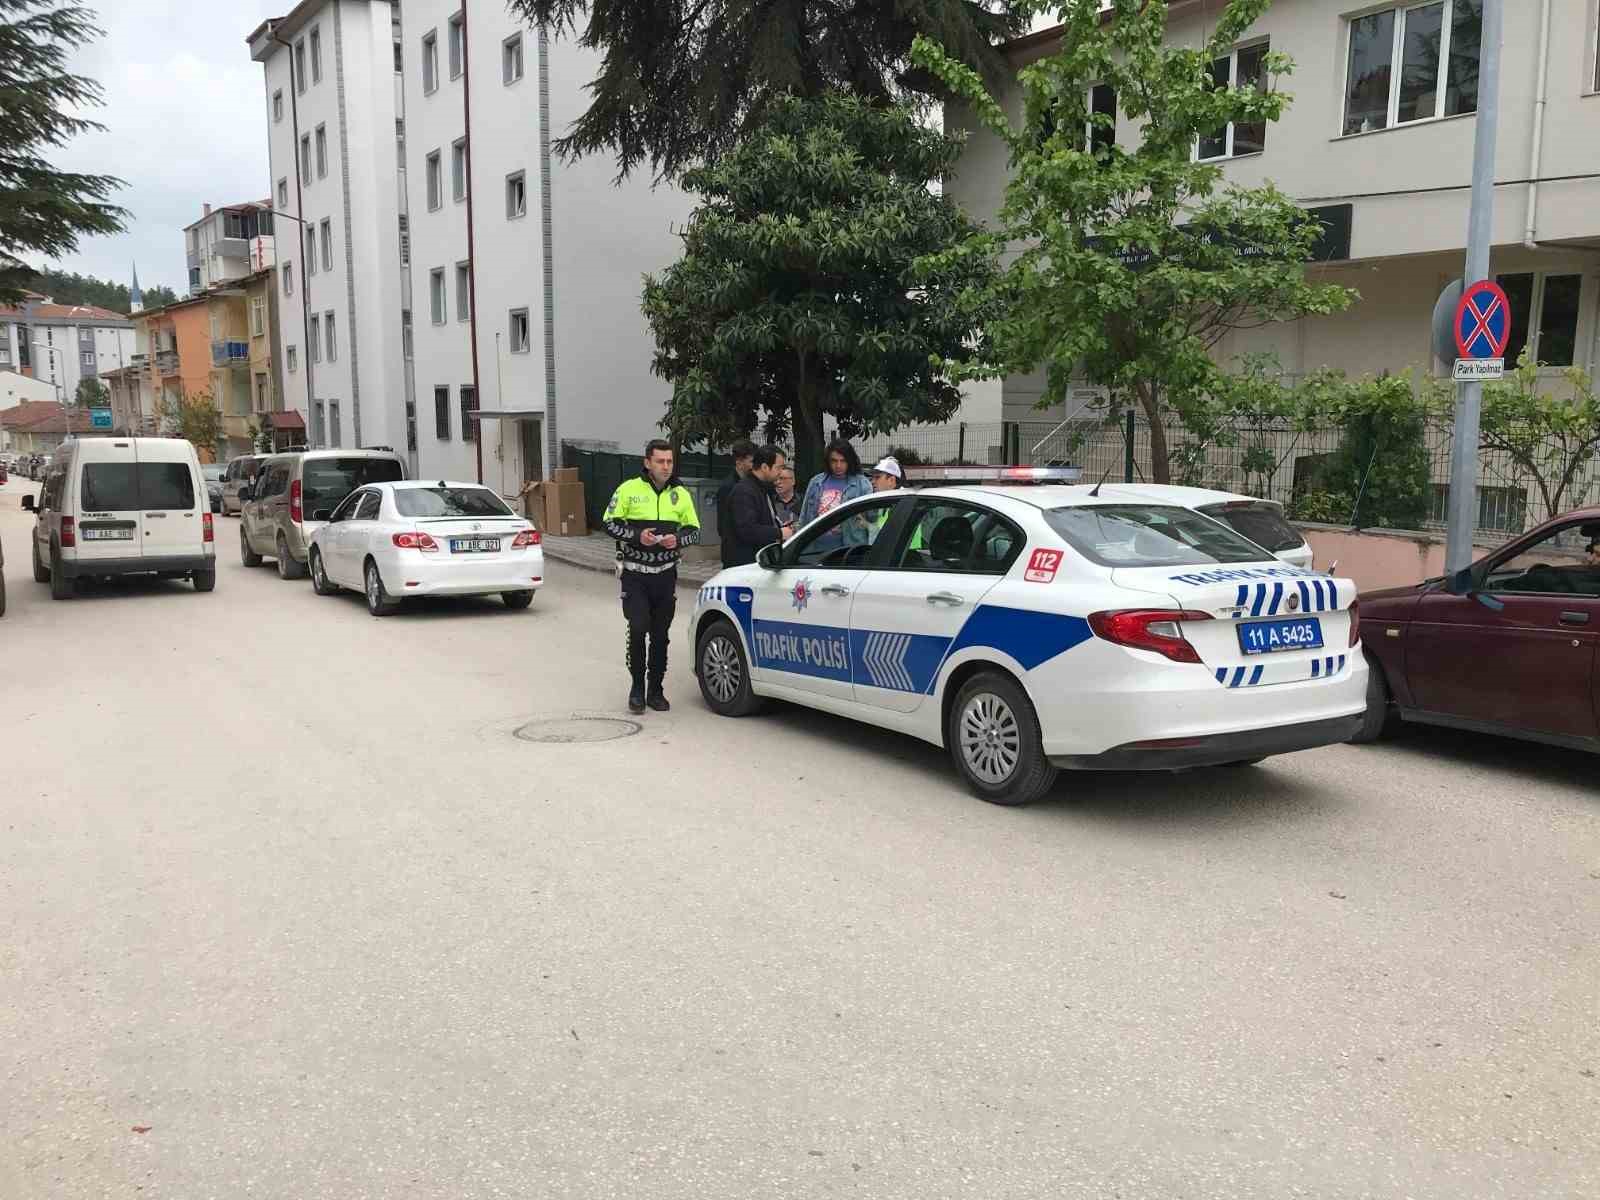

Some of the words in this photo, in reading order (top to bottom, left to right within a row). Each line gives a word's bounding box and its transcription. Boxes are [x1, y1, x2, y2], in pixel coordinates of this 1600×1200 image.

[1457, 364, 1474, 374] Park
[455, 540, 464, 550] 11
[1033, 551, 1058, 569] 112
[1249, 628, 1265, 647] 11
[1269, 627, 1281, 645] A
[1281, 624, 1314, 644] 5425
[755, 630, 802, 662] TRAFİK
[802, 635, 848, 669] POLİSİ
